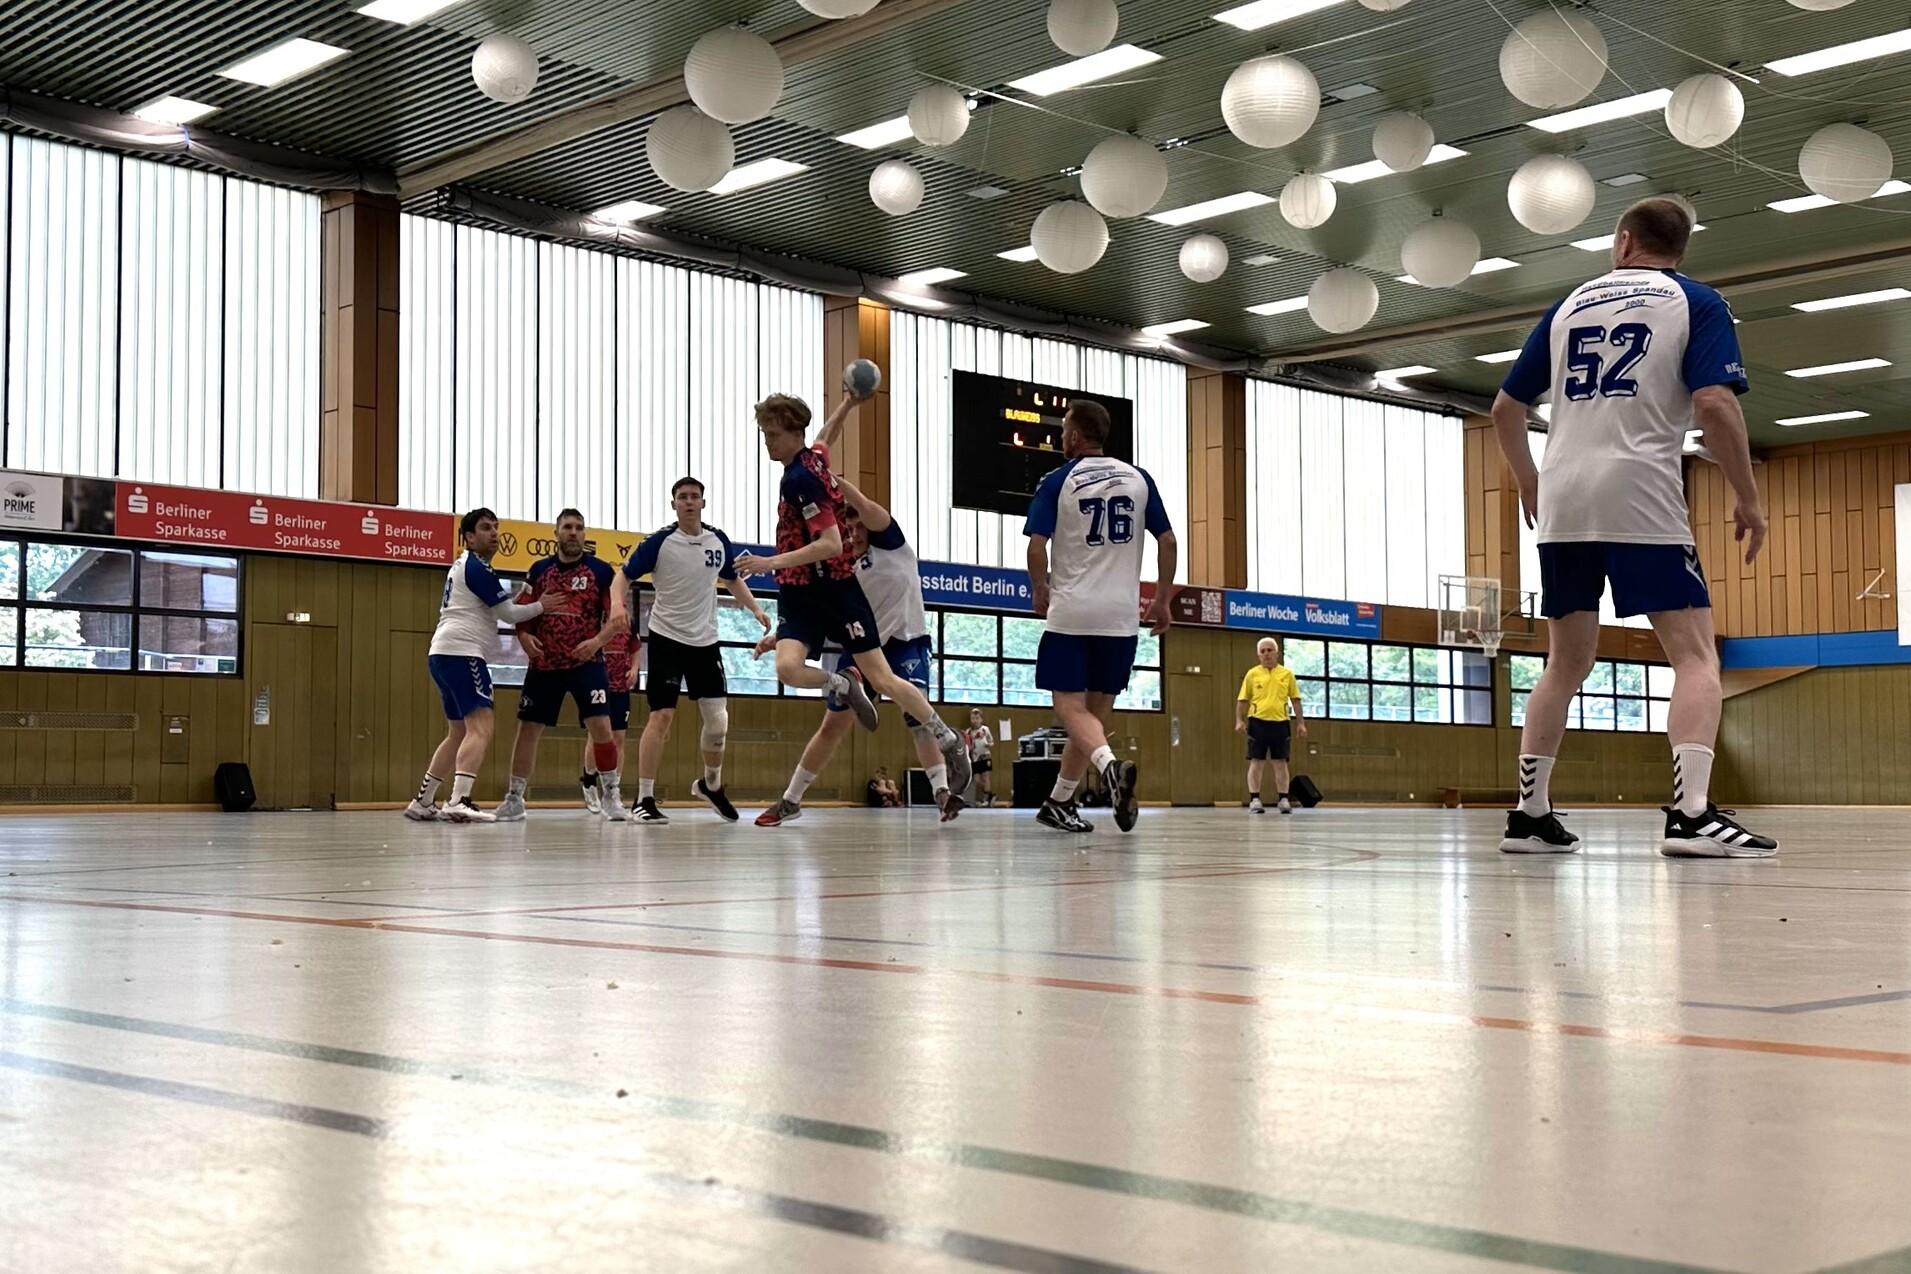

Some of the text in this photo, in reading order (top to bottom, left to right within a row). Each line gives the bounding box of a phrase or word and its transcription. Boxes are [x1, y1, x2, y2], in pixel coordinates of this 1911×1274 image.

[1632, 285, 1676, 297] Spandau
[1565, 322, 1653, 402] 52
[4, 499, 36, 514] PRIME
[156, 502, 212, 520] Berliner
[274, 513, 327, 530] Berliner
[1079, 495, 1135, 547] 76
[155, 521, 227, 540] Sparkasse
[385, 524, 433, 540] Berliner
[274, 532, 341, 550] Sparkasse
[384, 541, 446, 559] Sparkasse
[705, 549, 722, 568] 39
[571, 576, 588, 590] 23
[920, 574, 969, 593] sstadt
[972, 576, 1015, 597] Berlin
[1229, 601, 1267, 619] Berliner
[1267, 604, 1299, 622] Woche
[1305, 607, 1350, 627] Volksblatt
[845, 620, 866, 640] 14
[590, 689, 607, 704] 23
